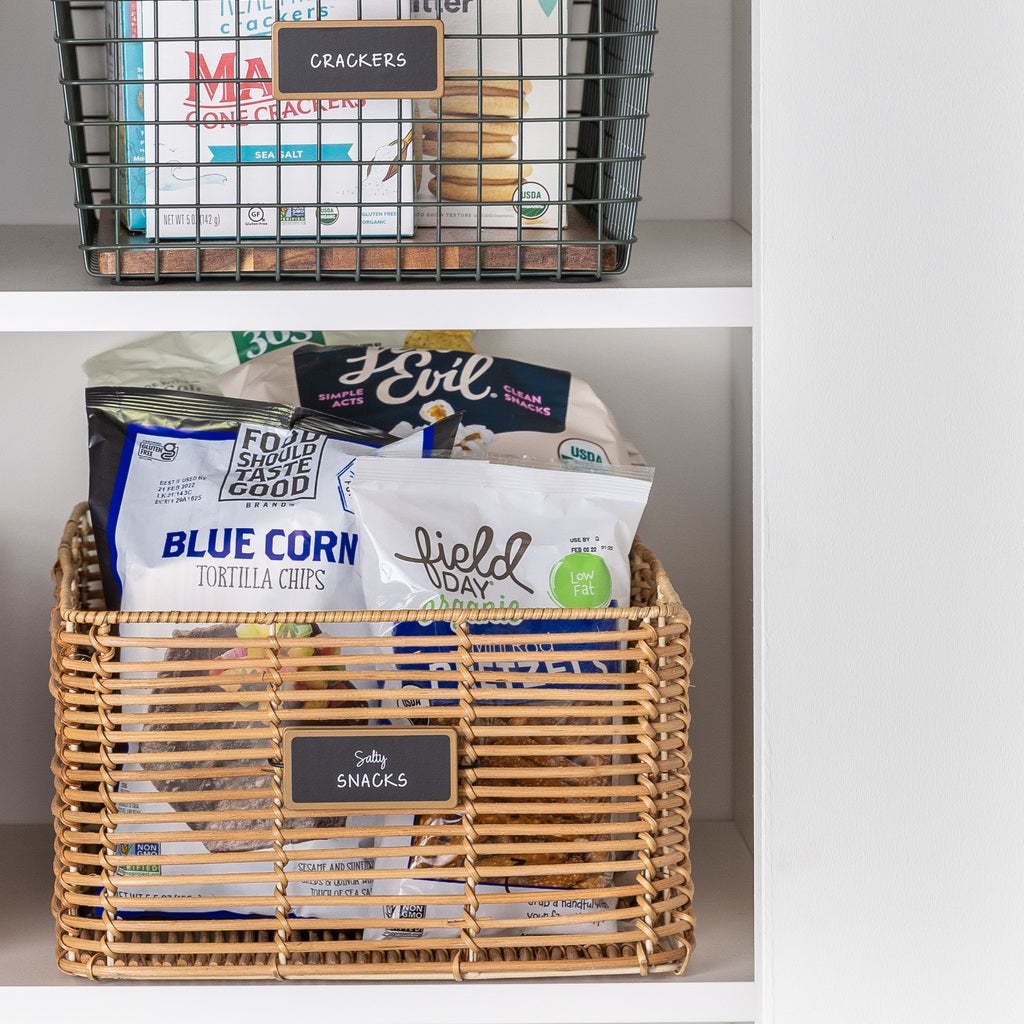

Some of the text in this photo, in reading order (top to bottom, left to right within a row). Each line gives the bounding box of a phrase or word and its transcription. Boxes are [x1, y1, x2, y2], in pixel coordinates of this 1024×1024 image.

[310, 52, 407, 69] CRACKERS
[255, 150, 304, 159] SEA SALT
[521, 191, 542, 199] USDA
[164, 214, 173, 225] NET
[175, 214, 185, 225] WT
[186, 214, 191, 225] 5
[318, 388, 364, 401] SIMPLE
[331, 397, 364, 409] ACTS
[503, 384, 542, 405] CLEAN
[503, 393, 552, 417] SNACKS
[141, 444, 163, 453] GLUTEN
[243, 428, 326, 454] FOOD
[140, 448, 153, 457] FREE
[237, 442, 318, 468] SHOULD
[571, 445, 603, 464] USDA
[235, 459, 312, 482] TASTE
[166, 484, 180, 492] FEB
[228, 475, 311, 498] GOOD
[245, 501, 288, 509] BRAND
[162, 527, 359, 566] BLUE CORN
[394, 525, 534, 595] field
[196, 564, 326, 591] TORTILLA CHIPS
[442, 572, 490, 599] DAY
[570, 569, 595, 585] Low
[573, 581, 596, 597] Fat
[353, 749, 388, 770] Salty
[336, 772, 408, 789] SNACKS
[297, 862, 345, 872] SESAME AND
[344, 888, 359, 896] SEA
